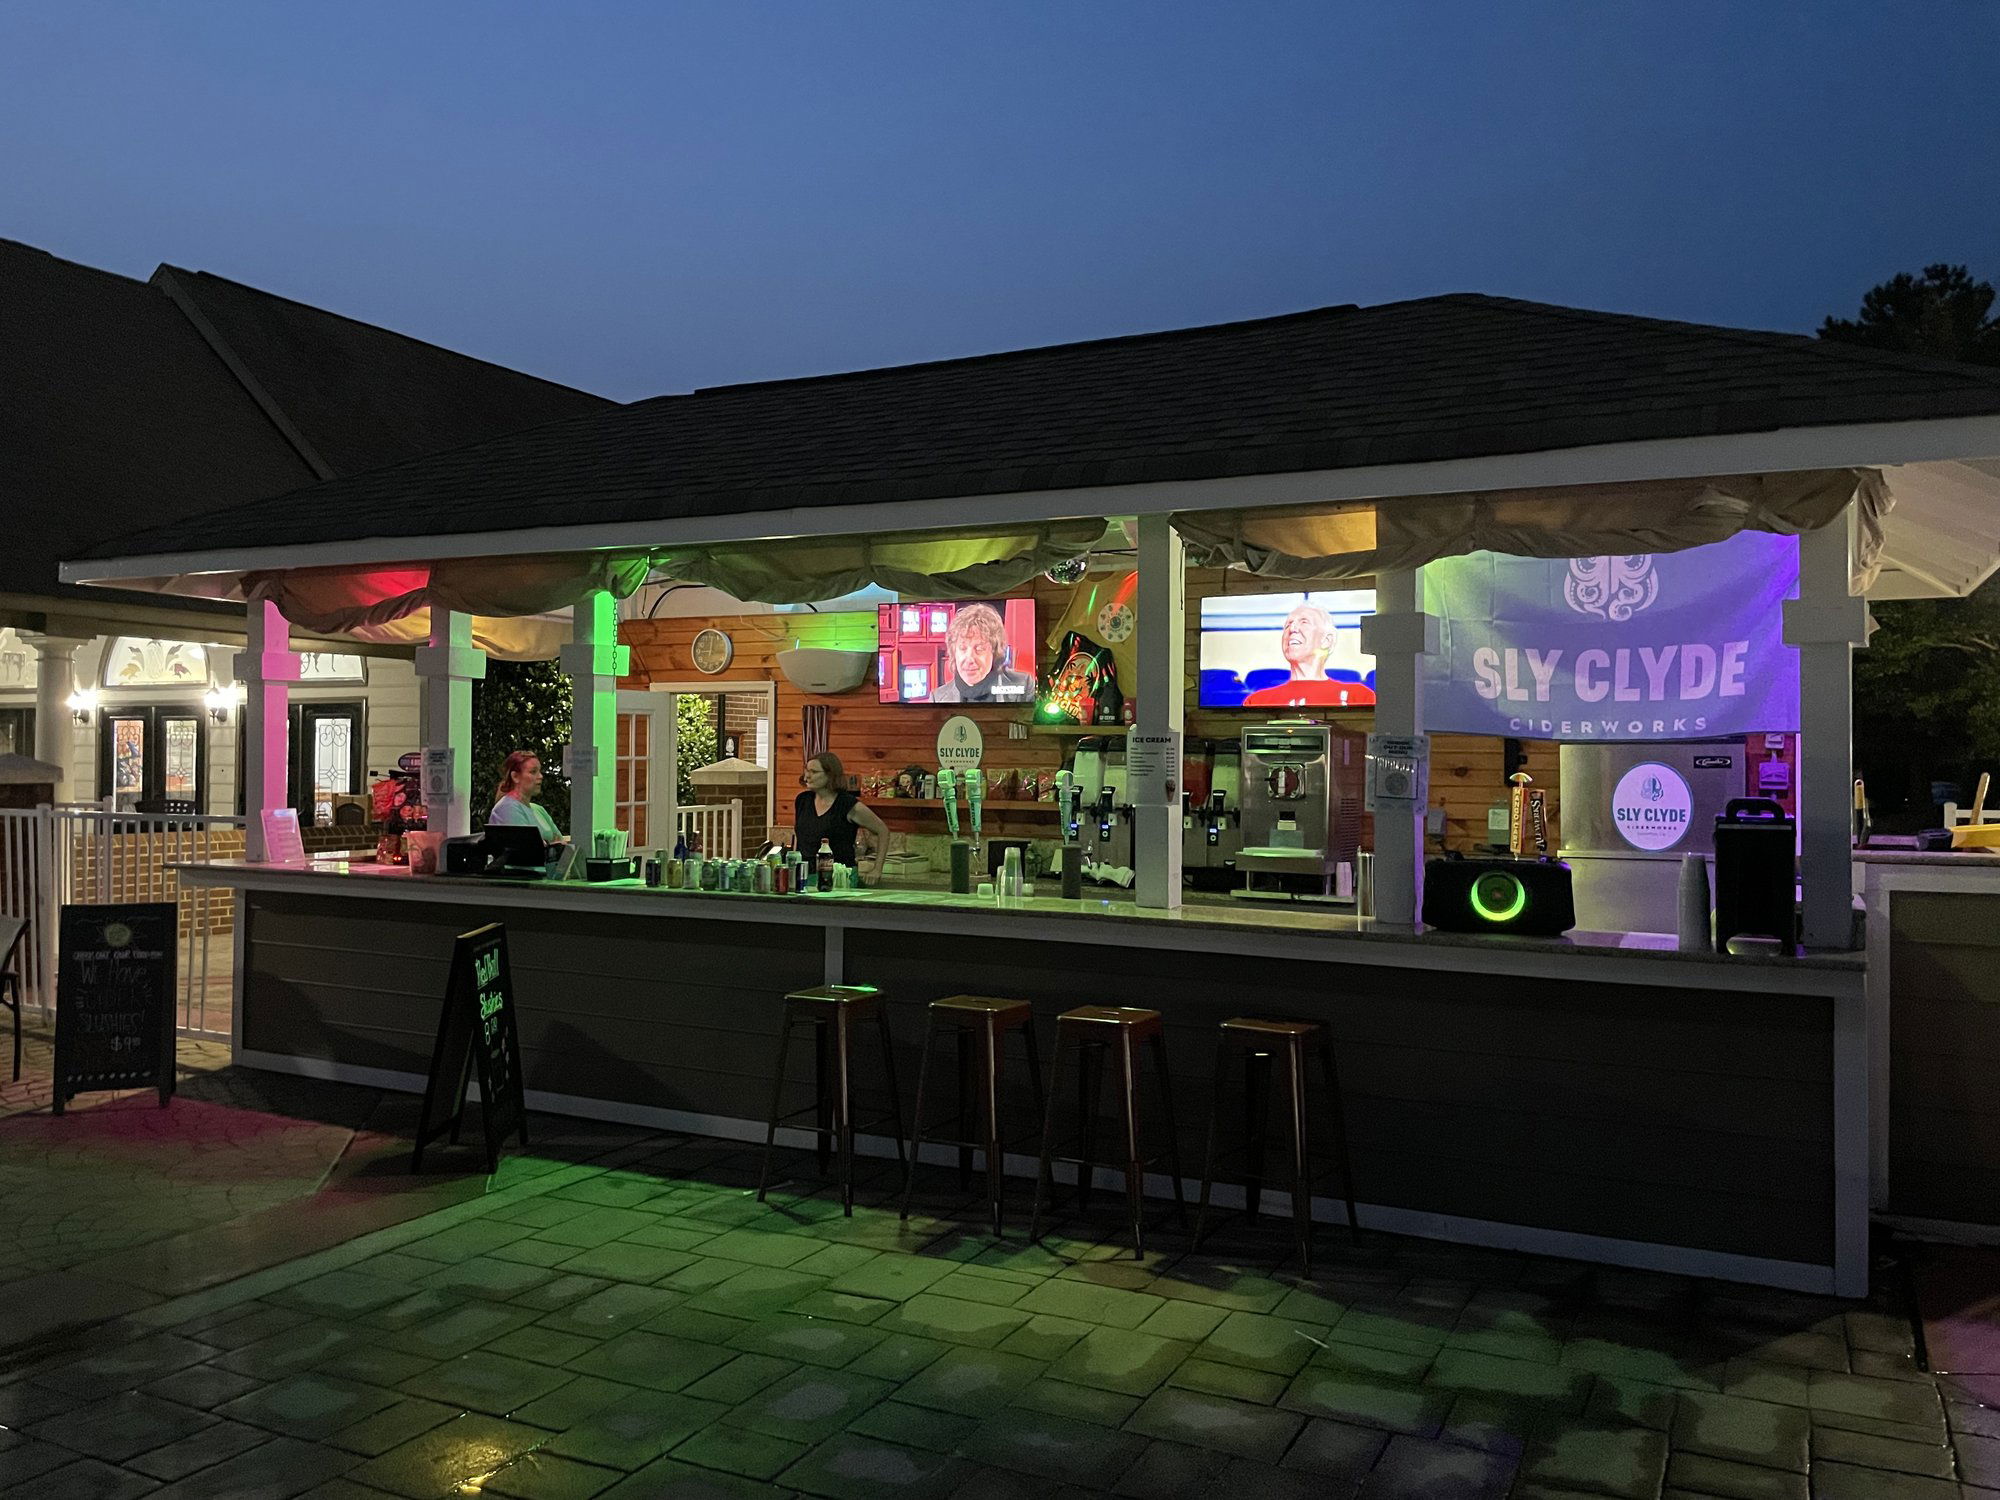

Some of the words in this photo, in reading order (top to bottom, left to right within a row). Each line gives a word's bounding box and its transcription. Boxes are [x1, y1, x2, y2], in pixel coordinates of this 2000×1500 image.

[1473, 646, 1564, 702] SLY
[1574, 641, 1749, 702] CLYDE
[1509, 717, 1707, 734] CIDERWORKS
[939, 747, 954, 757] SLY
[955, 747, 980, 758] CLYDE
[1617, 807, 1641, 821] SLY
[1644, 808, 1686, 822] CLYDE
